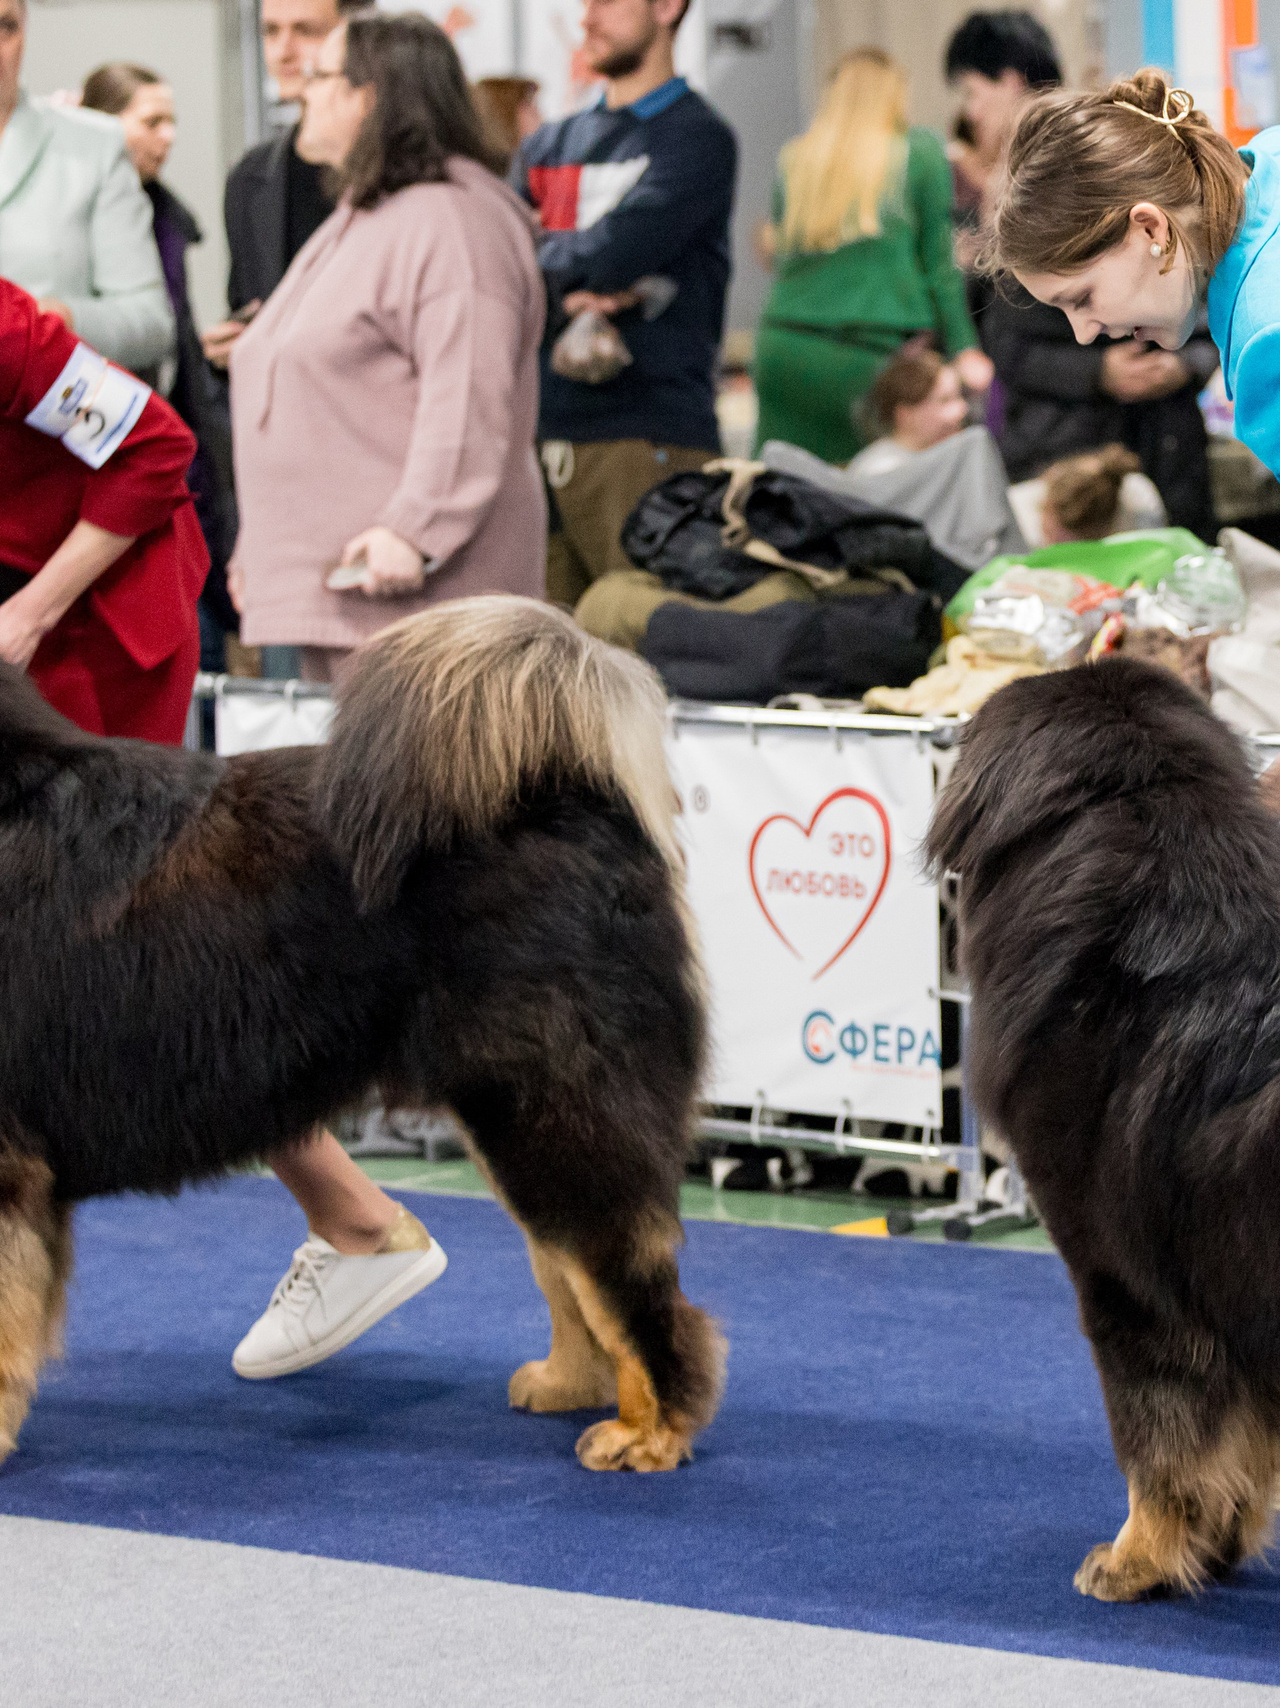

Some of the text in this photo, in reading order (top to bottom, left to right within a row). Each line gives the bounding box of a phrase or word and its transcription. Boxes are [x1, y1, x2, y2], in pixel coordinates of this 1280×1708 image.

[830, 833, 875, 858] ЭТО
[767, 869, 866, 899] ЛЮБОВЬ
[802, 1010, 941, 1070] СФЕРА
